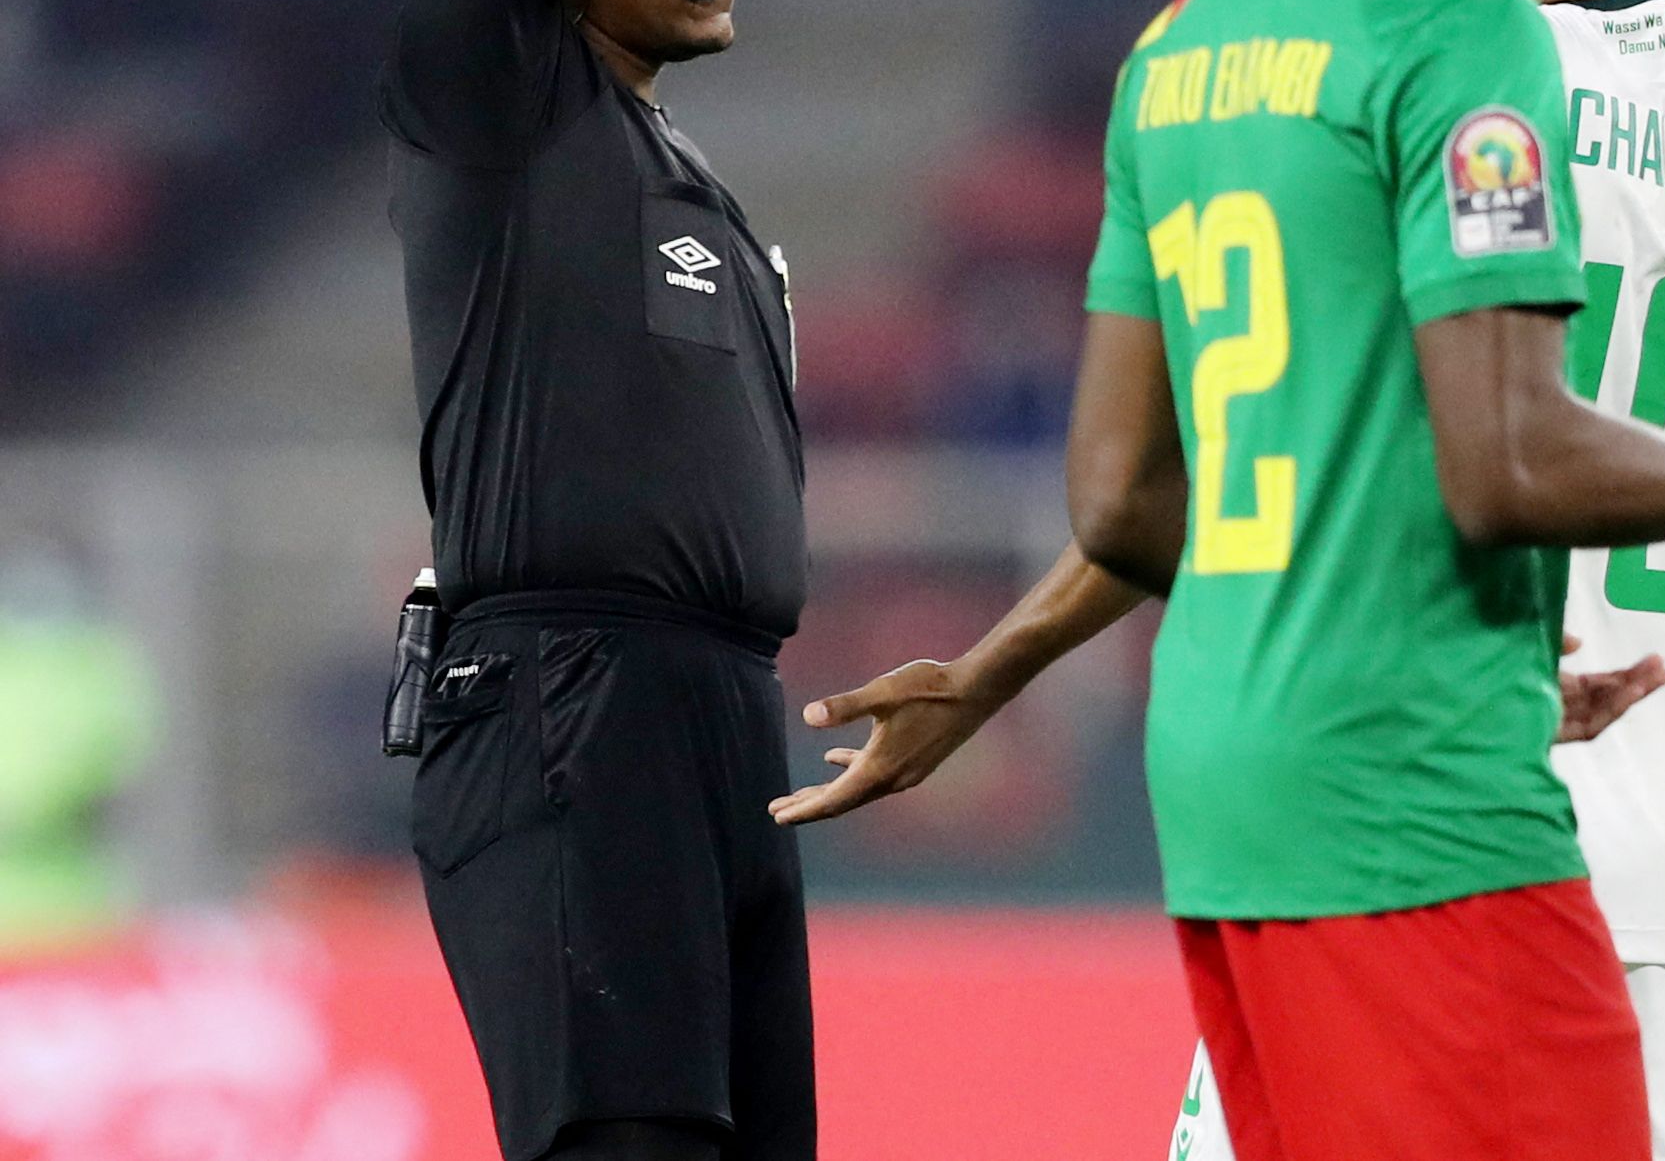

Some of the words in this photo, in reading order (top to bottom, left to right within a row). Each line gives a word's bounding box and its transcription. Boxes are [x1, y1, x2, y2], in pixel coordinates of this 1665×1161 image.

[1602, 18, 1641, 36] Wassi
[1618, 39, 1655, 55] Damu
[665, 270, 716, 294] umbro
[1147, 190, 1296, 575] 12
